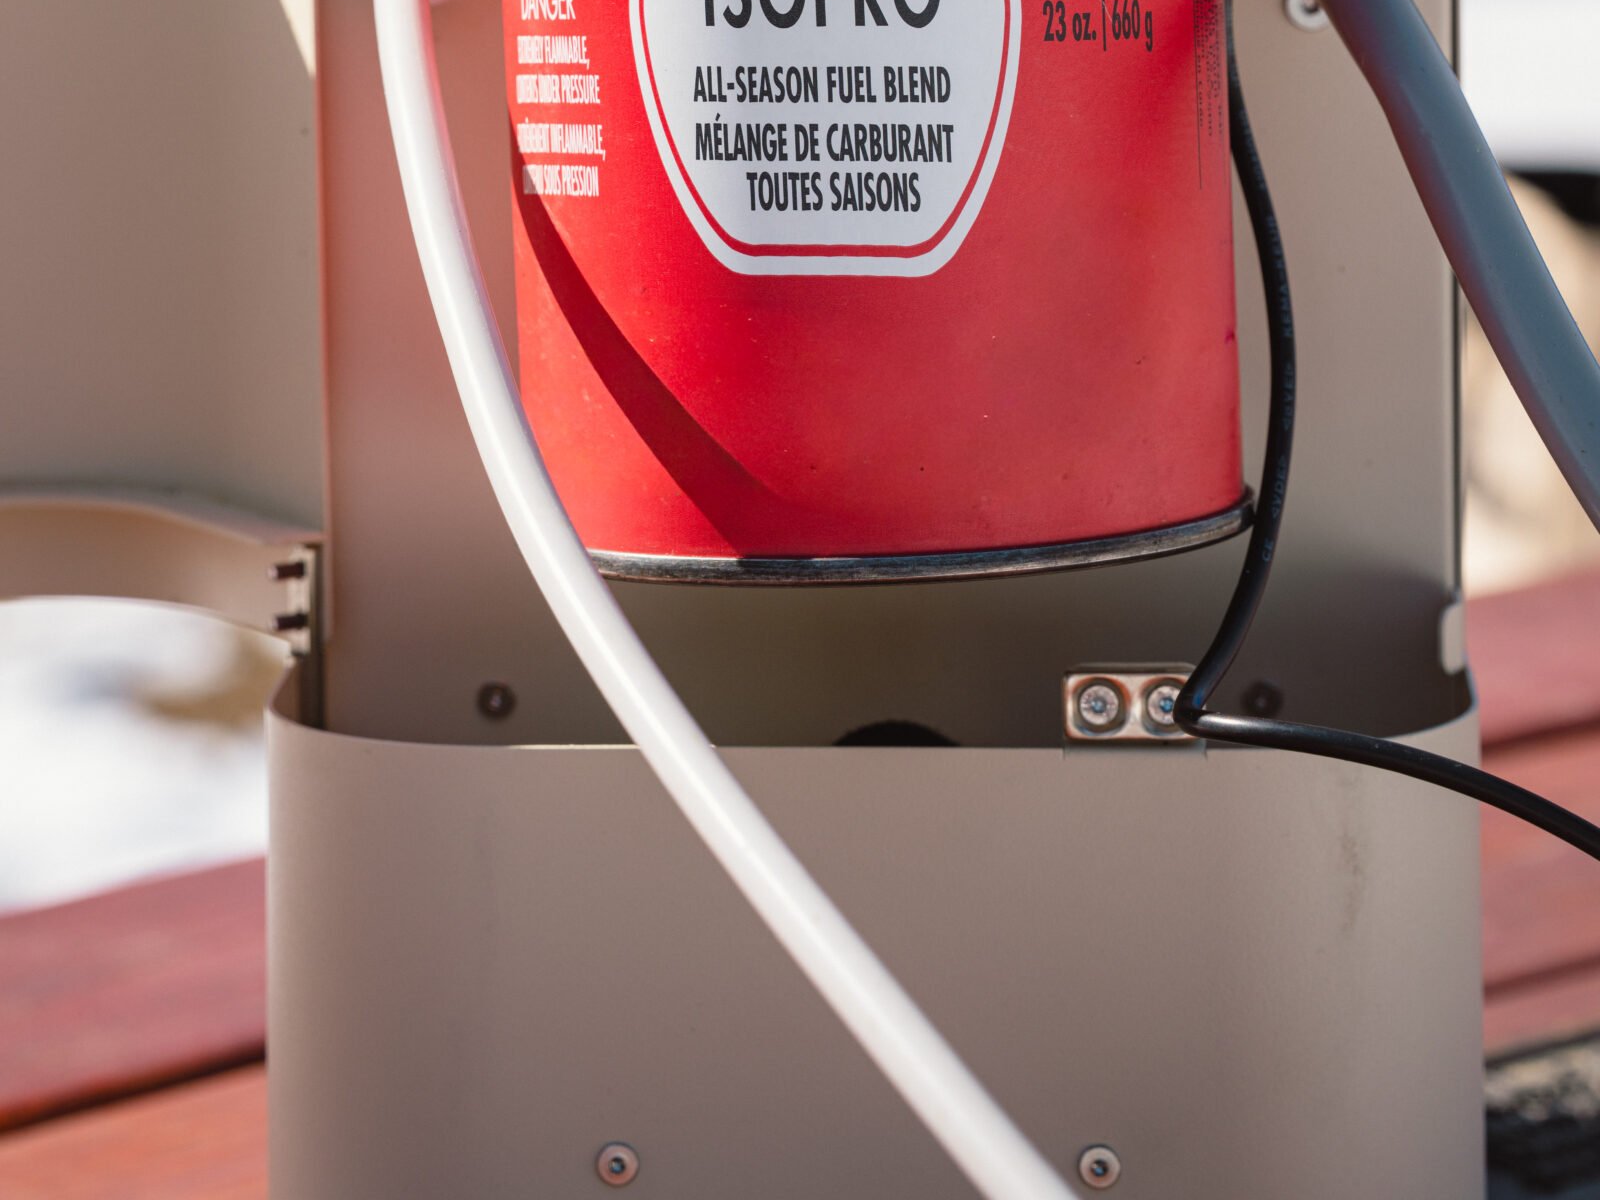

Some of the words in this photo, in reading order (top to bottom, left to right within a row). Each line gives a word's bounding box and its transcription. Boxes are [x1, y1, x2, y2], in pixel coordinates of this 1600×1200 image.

[1042, 0, 1066, 42] 23
[1072, 10, 1097, 42] oz.
[1144, 10, 1154, 52] g
[544, 35, 590, 69] FLAMMABLE,
[561, 74, 601, 104] PRESSURE
[693, 66, 819, 104] ALL-SEASON
[826, 66, 877, 103] FUEL
[884, 66, 951, 103] BLEND
[695, 113, 787, 162] MÉLANGE
[794, 123, 820, 162] DE
[826, 123, 954, 163] CARBURANT
[543, 164, 561, 196] SOUS
[561, 164, 599, 197] PRESSION
[746, 171, 823, 212] TOUTES
[830, 171, 921, 213] SAISONS
